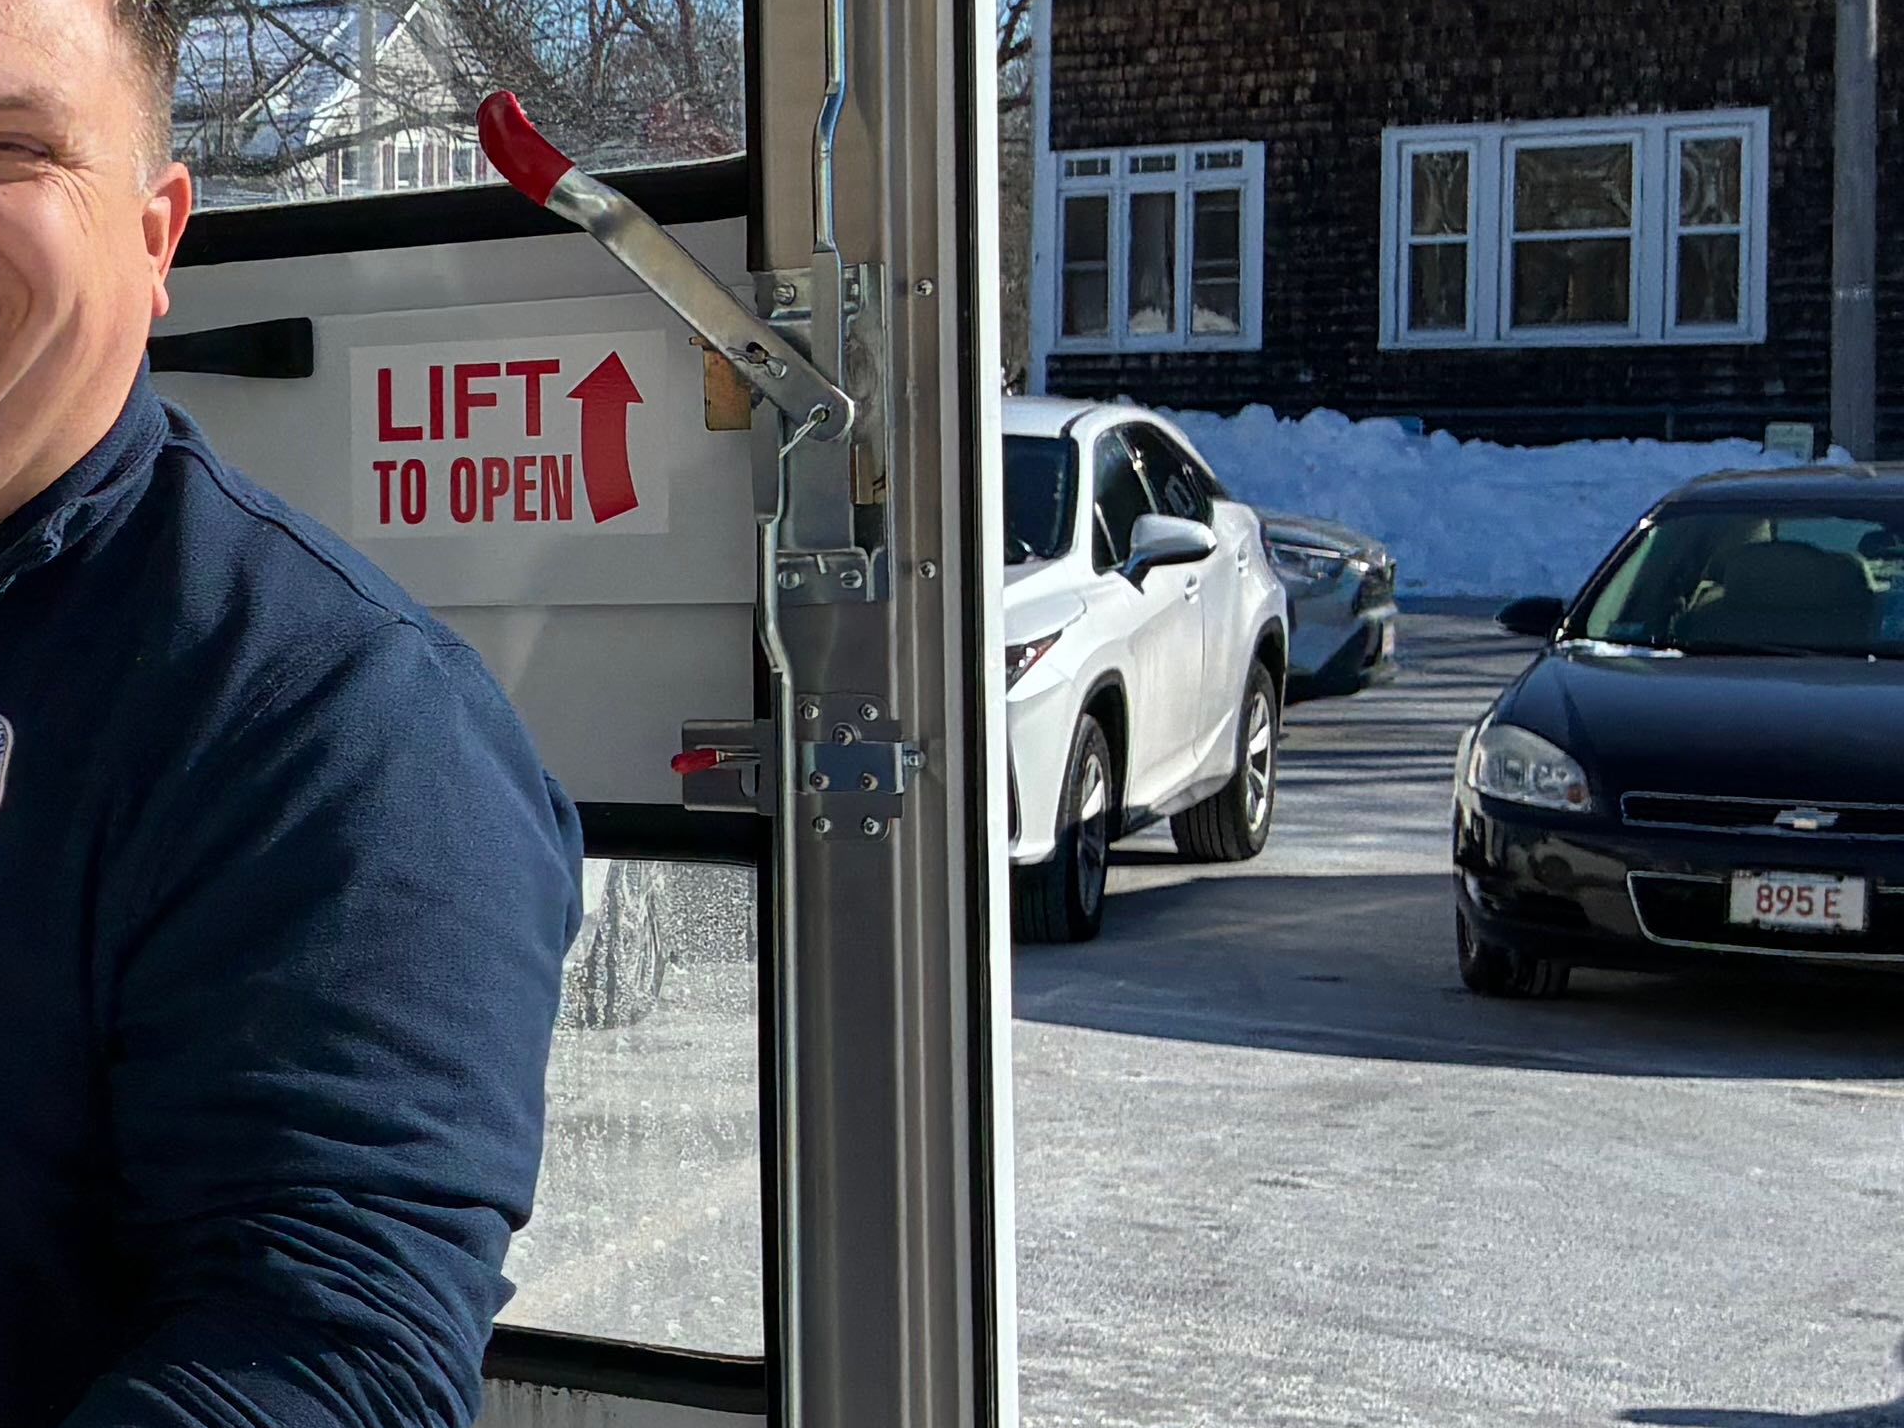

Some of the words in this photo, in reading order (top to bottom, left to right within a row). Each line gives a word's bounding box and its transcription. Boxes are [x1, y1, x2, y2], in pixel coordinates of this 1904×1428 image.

[377, 359, 560, 442] LIFT
[373, 458, 427, 525] TO
[450, 454, 573, 524] OPEN
[1756, 884, 1815, 917] 895
[1824, 887, 1841, 919] E
